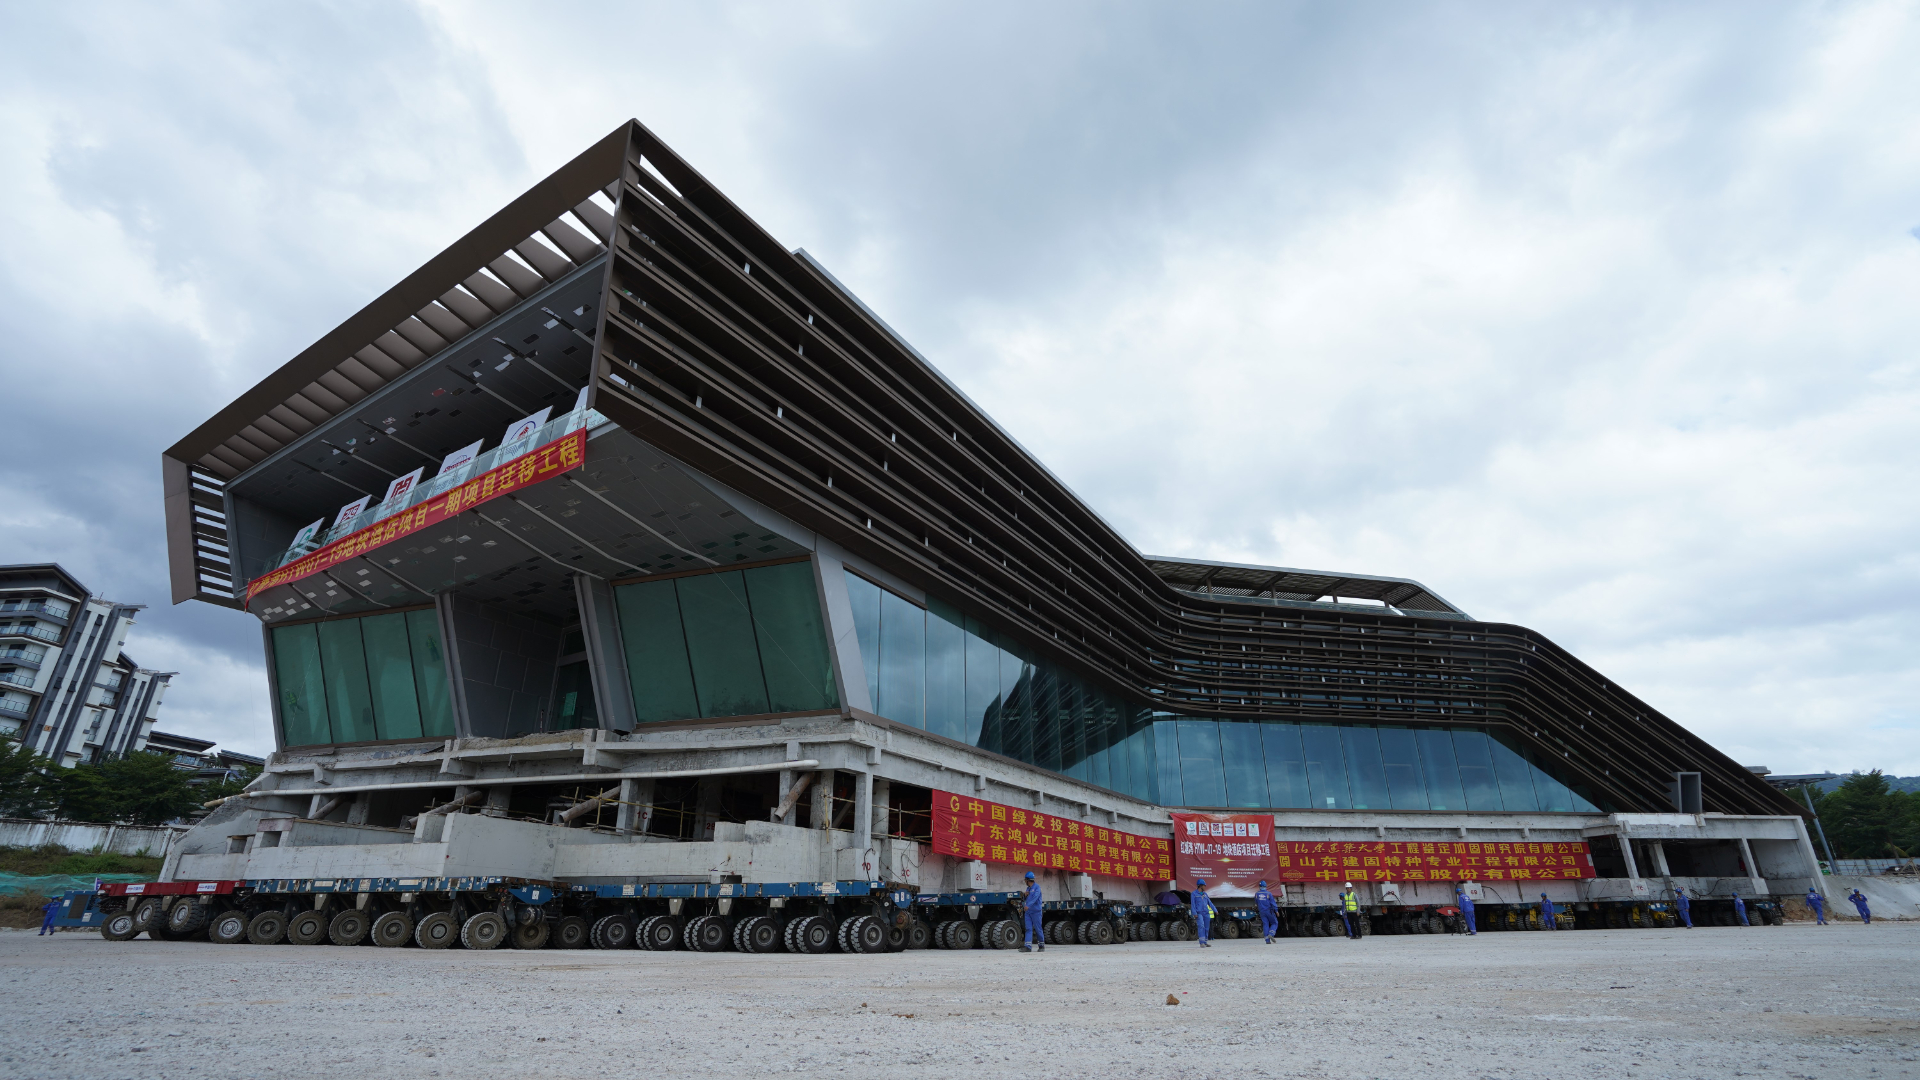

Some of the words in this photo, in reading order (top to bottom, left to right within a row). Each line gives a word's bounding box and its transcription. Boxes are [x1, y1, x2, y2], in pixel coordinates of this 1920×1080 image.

[968, 800, 1169, 851] 中国绿发投资集团有限公司
[969, 821, 1170, 866] 广东鸿业工程项目管理有限公司
[967, 841, 1171, 879] 海南诚创建设工程有限公司
[1299, 855, 1576, 867] 山东建固特种专业工程有限公司
[1316, 868, 1582, 880] 中国外运股份有限公司
